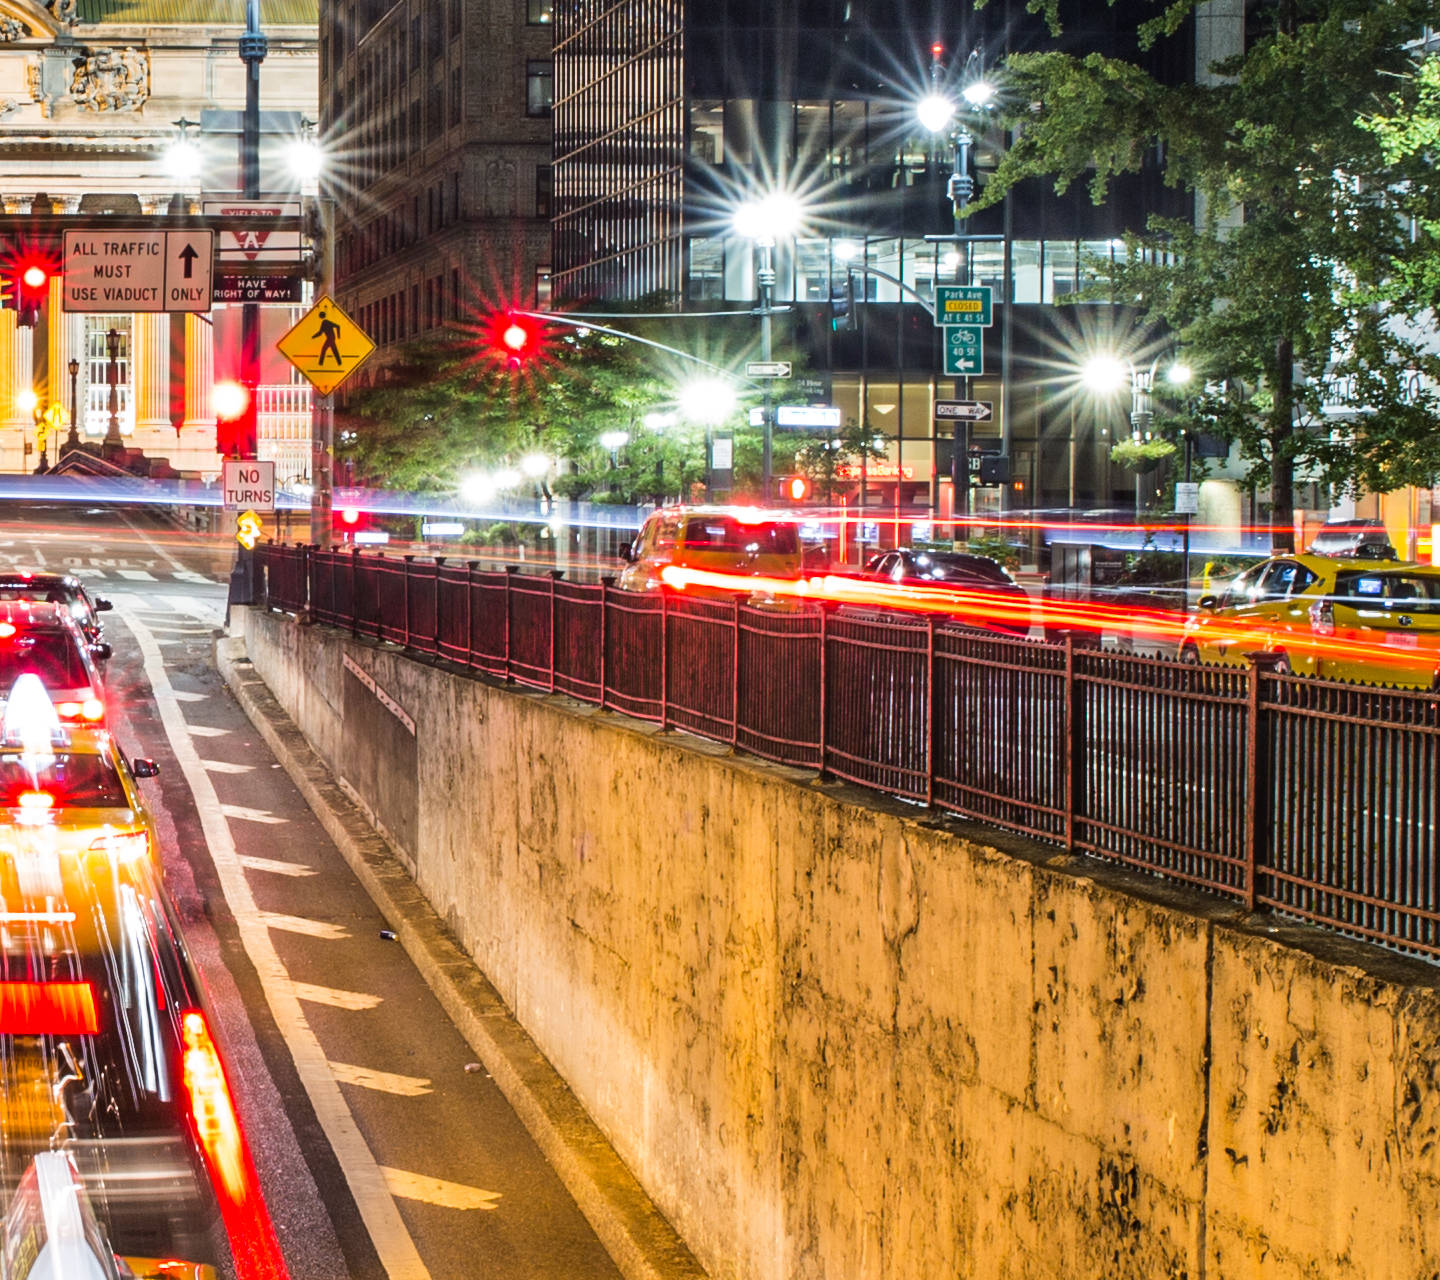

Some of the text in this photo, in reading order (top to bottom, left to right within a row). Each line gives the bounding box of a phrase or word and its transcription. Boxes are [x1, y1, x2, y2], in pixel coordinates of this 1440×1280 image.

[73, 242, 160, 256] ALL TRAFFIC
[94, 265, 131, 278] MUST
[237, 280, 267, 289] HAVE
[72, 288, 158, 301] USE VIADUCT
[171, 288, 204, 301] ONLY
[214, 289, 291, 298] RIGHT OF WAY!
[945, 290, 983, 299] Park Ave
[948, 302, 979, 310] CLOSED
[943, 313, 952, 322] AT
[956, 314, 961, 322] E
[964, 314, 973, 322] 41
[952, 347, 976, 356] 40 St
[939, 406, 986, 415] ONE WAY
[239, 469, 260, 484] NO
[227, 490, 271, 503] TURNS
[63, 557, 157, 568] ONLY
